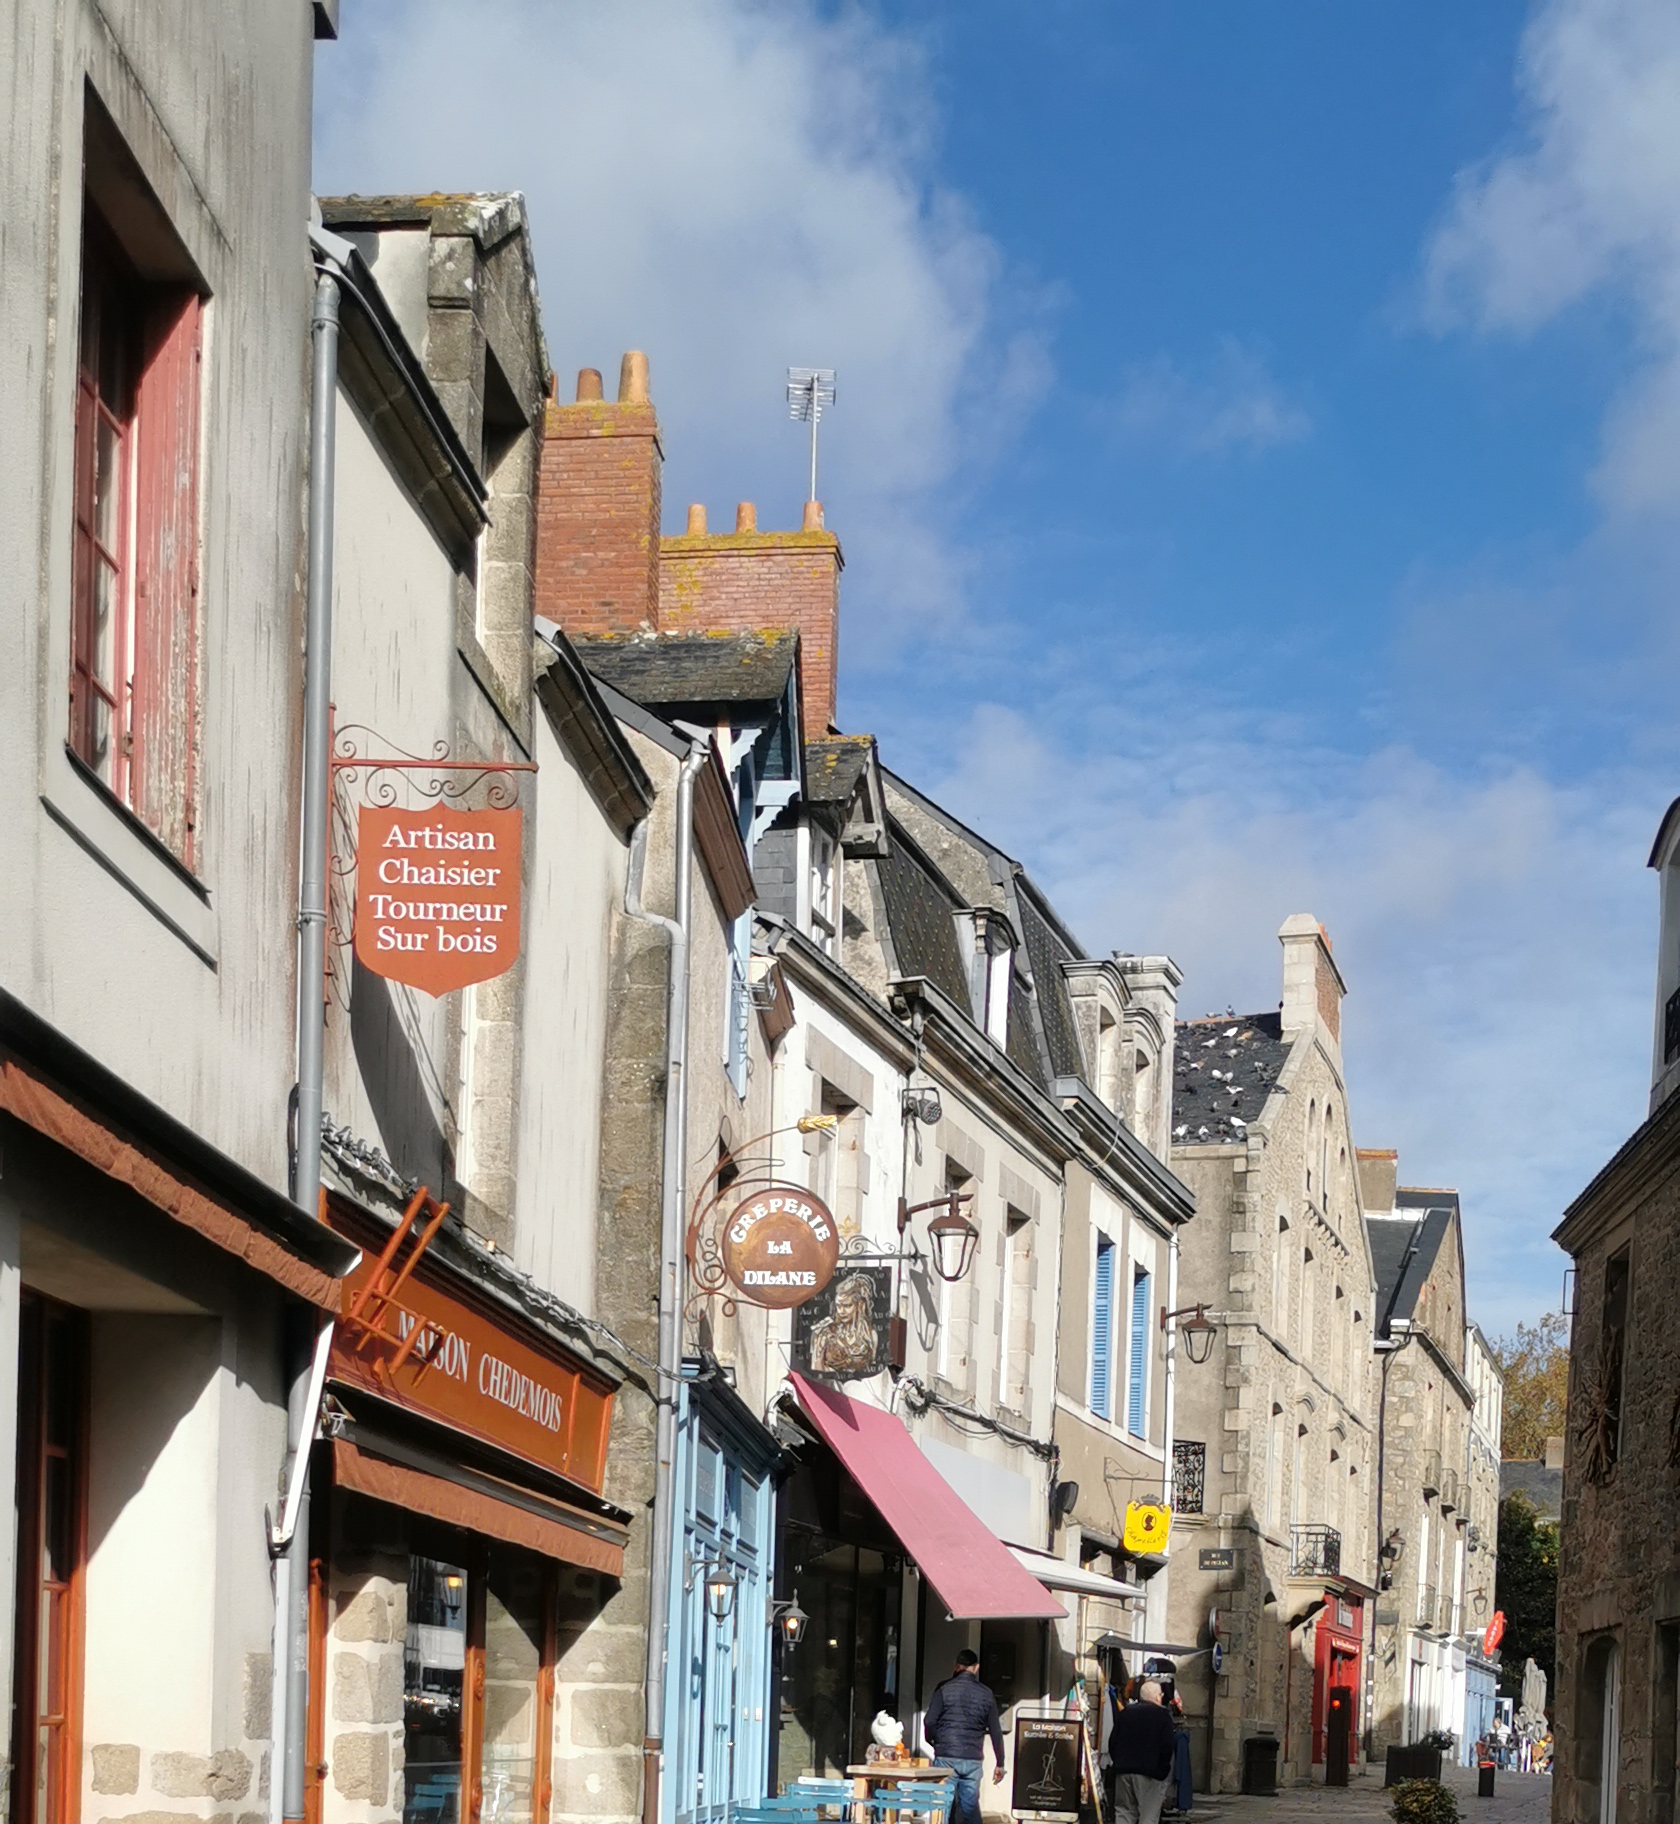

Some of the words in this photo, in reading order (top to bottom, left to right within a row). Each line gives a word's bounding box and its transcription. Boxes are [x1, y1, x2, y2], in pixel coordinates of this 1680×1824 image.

[382, 823, 497, 851] Artisan
[378, 857, 501, 887] Chaisier
[368, 893, 508, 923] Tourneur
[376, 925, 430, 951] Sur
[436, 926, 498, 954] bois
[767, 1240, 794, 1255] LA
[743, 1269, 817, 1286] DILANE
[478, 1353, 563, 1433] CHEDEMOIS
